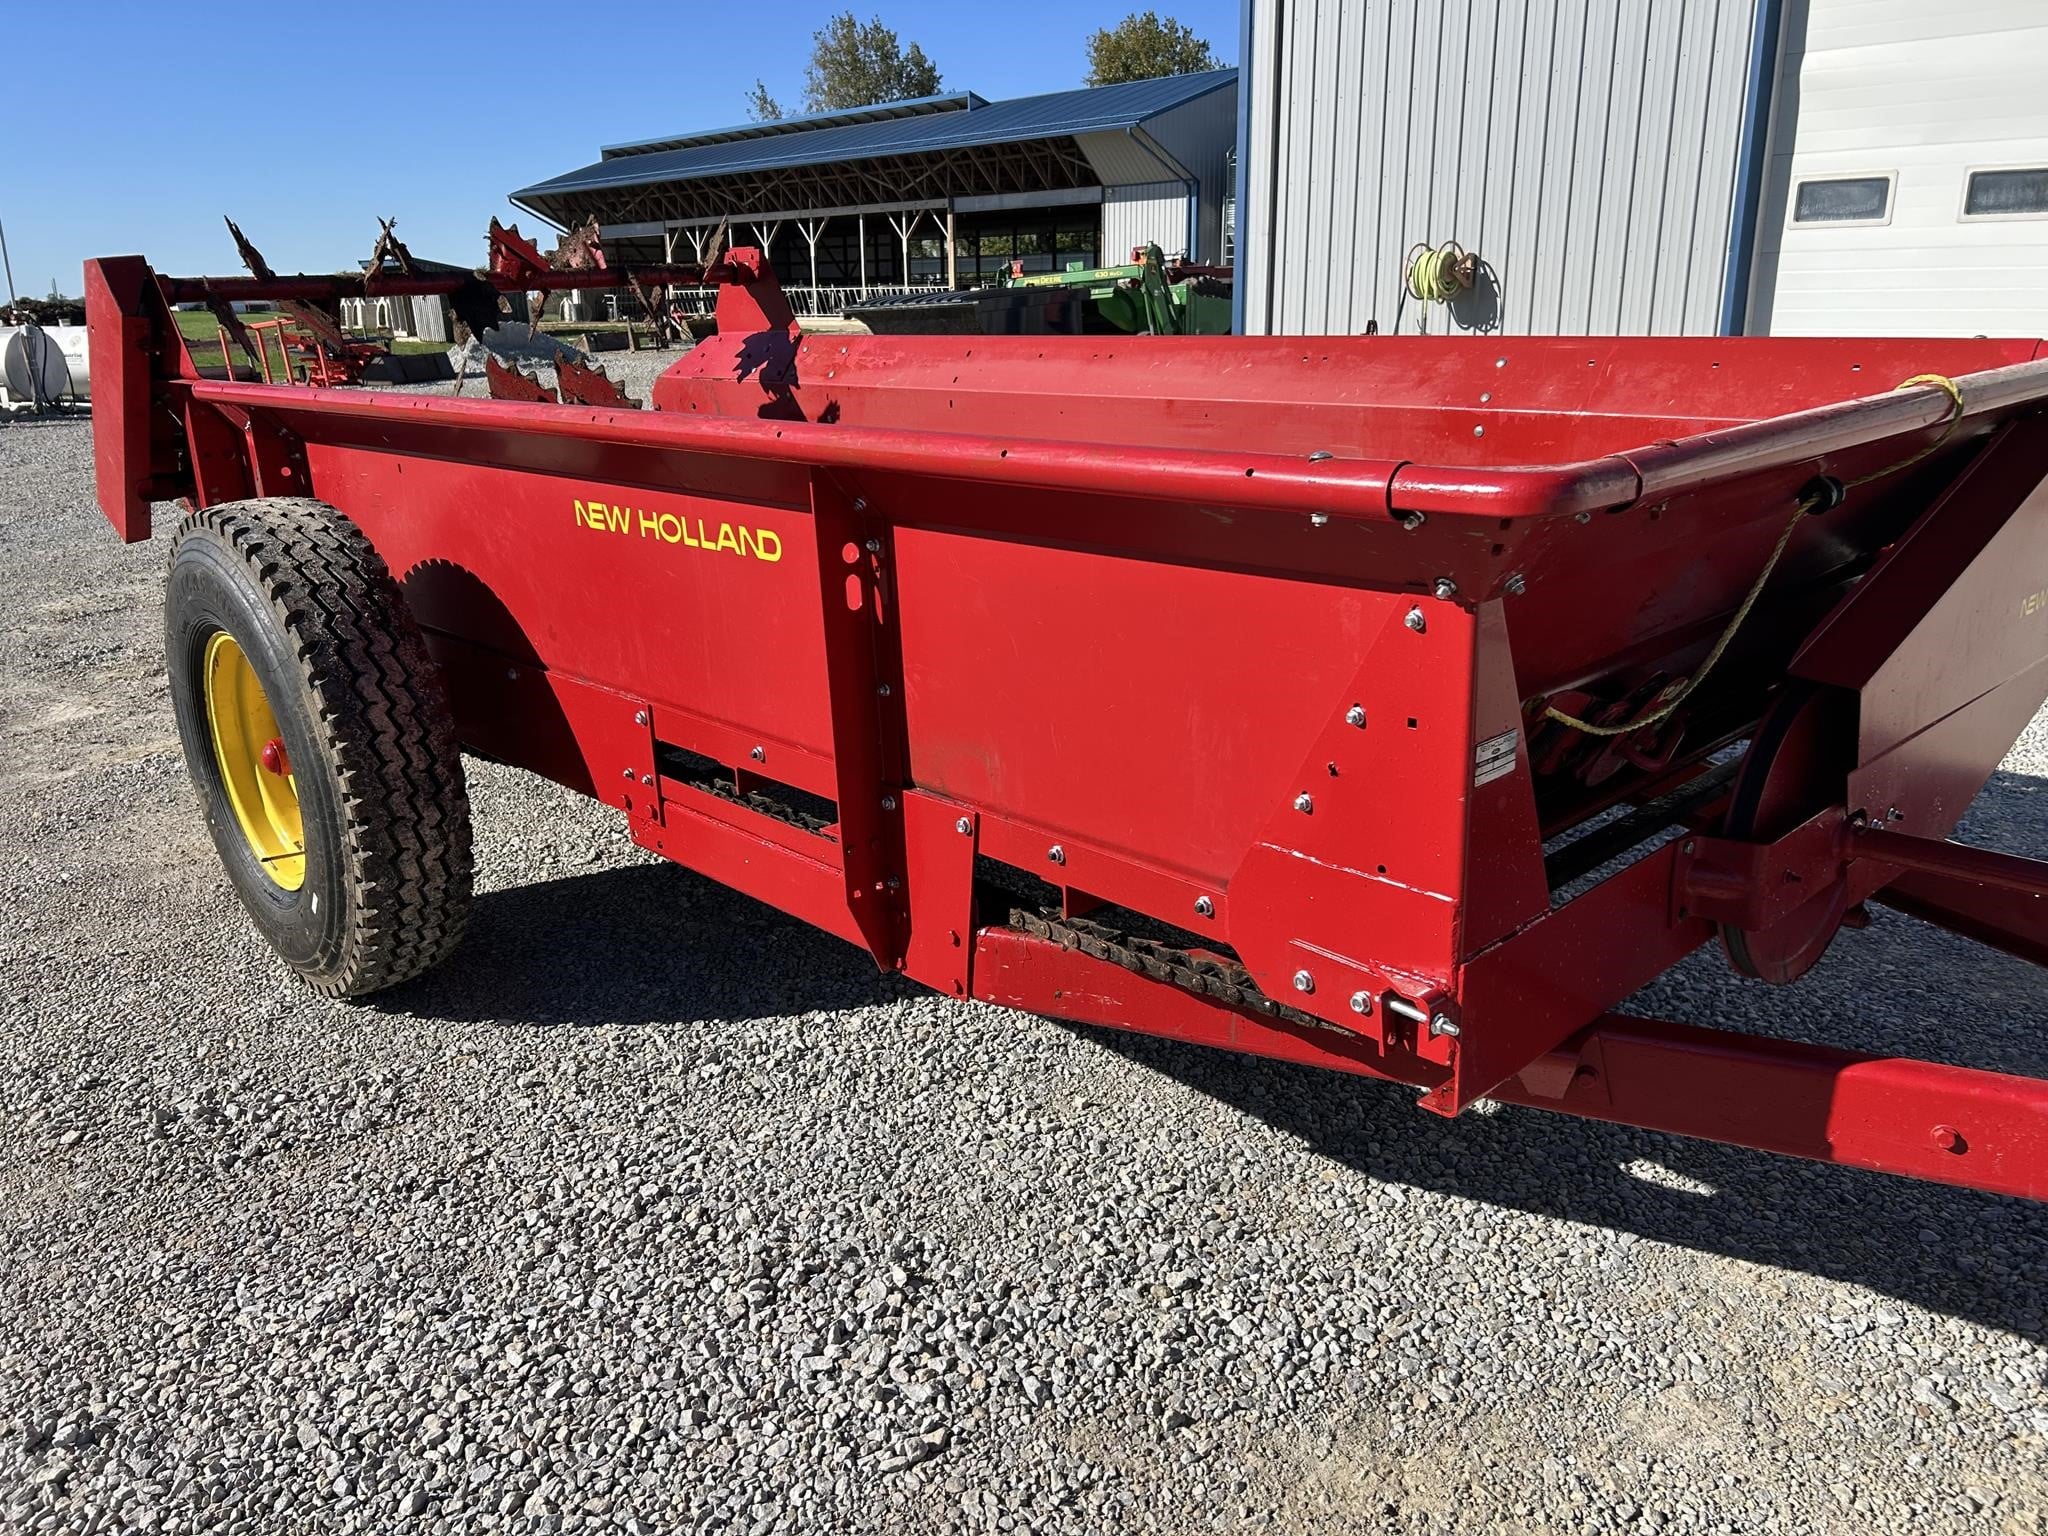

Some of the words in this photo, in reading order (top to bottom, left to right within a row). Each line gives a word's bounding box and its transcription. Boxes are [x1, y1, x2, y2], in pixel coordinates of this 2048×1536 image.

[1040, 275, 1063, 285] DEERE
[573, 499, 631, 536] NEW
[638, 509, 783, 563] HOLLAND
